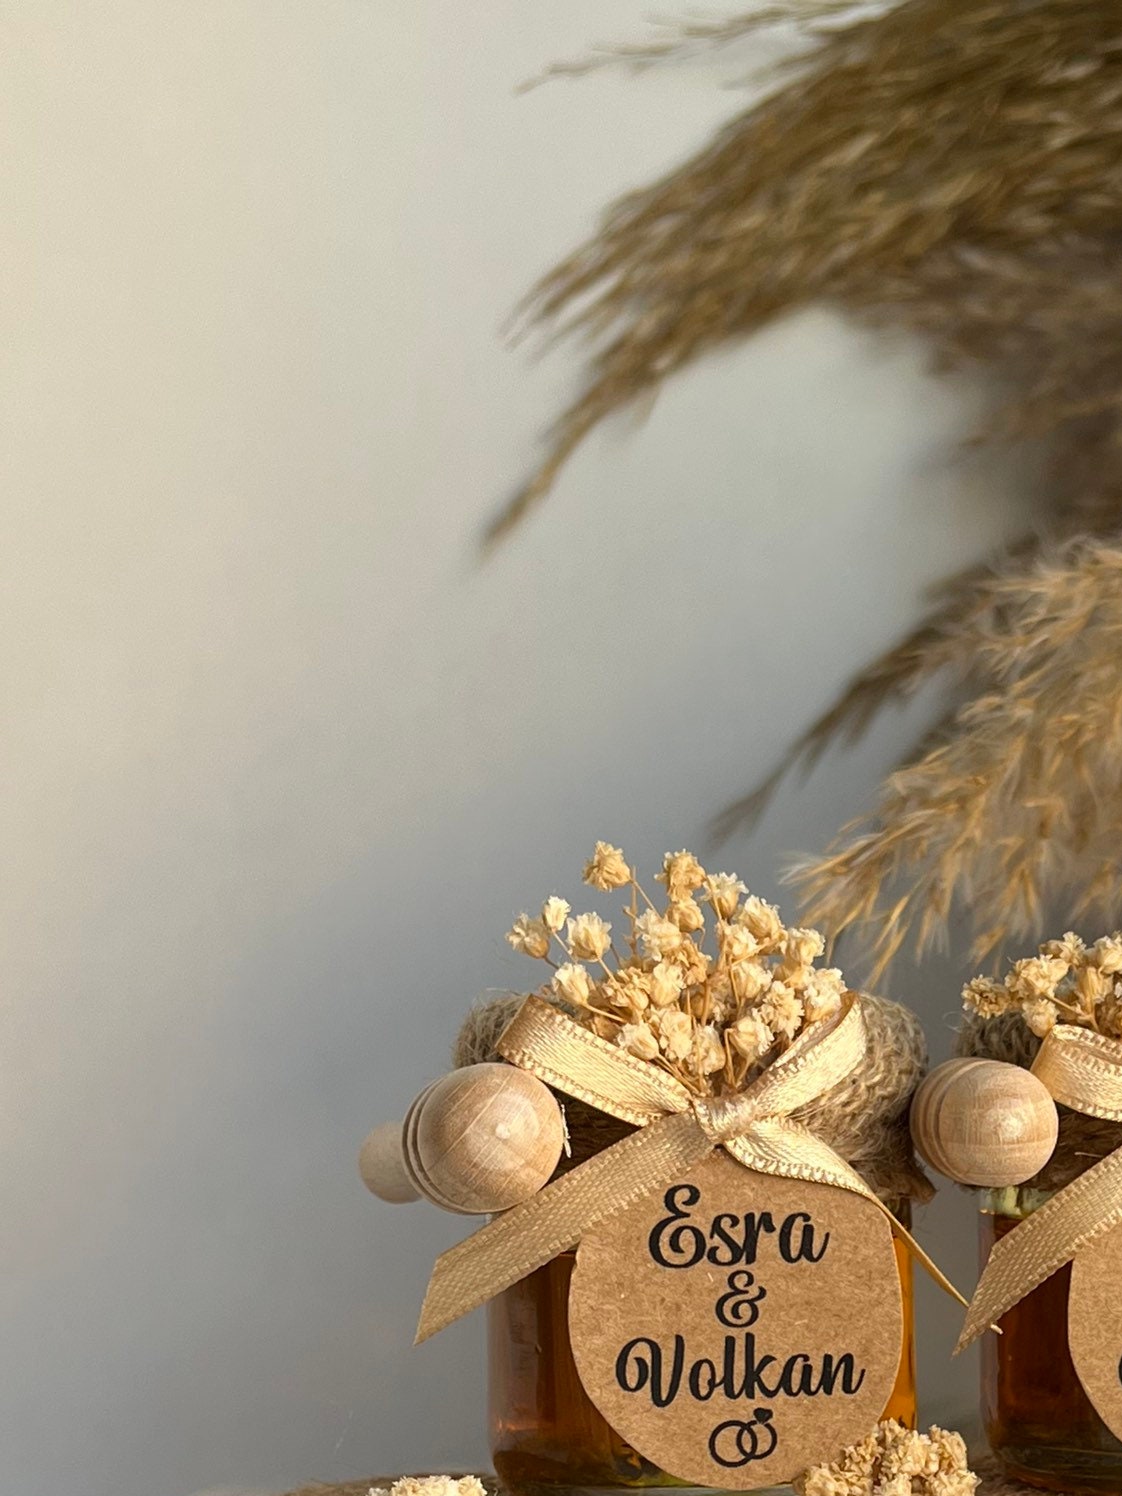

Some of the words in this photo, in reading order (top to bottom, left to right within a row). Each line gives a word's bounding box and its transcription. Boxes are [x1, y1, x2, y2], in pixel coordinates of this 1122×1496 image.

[649, 1184, 830, 1269] Esra
[715, 1269, 767, 1328] &
[615, 1331, 866, 1408] Volkan
